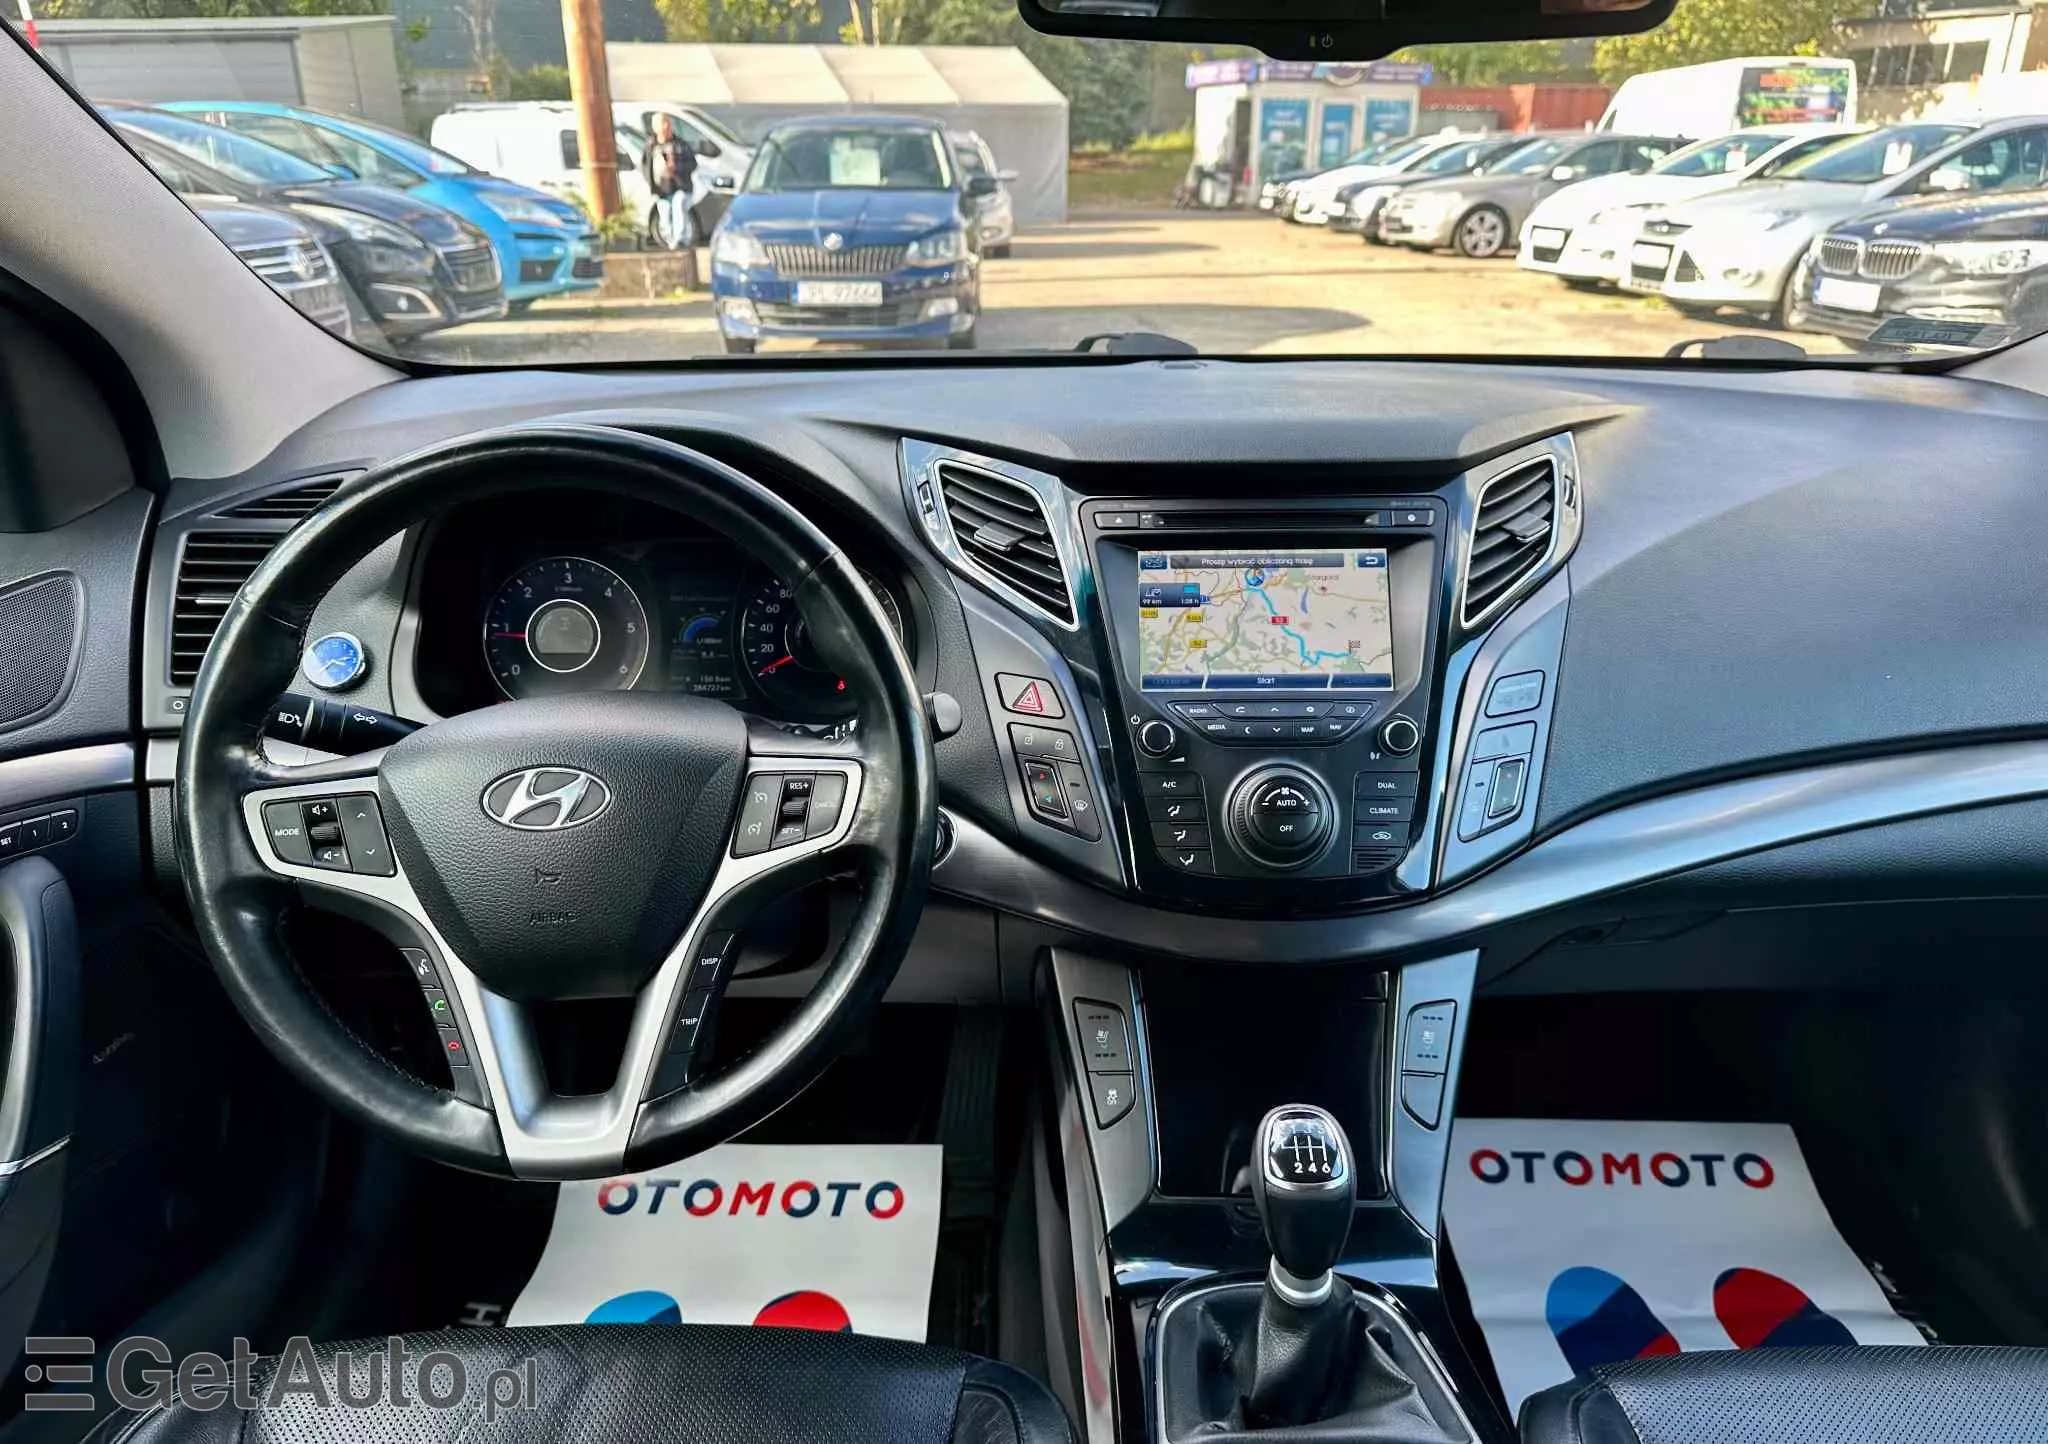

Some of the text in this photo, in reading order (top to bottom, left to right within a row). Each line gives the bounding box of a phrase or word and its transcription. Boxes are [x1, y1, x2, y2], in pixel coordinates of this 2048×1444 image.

[564, 573, 573, 584] 3
[523, 586, 533, 598] 2
[603, 587, 613, 598] 4
[779, 589, 793, 599] 80
[765, 604, 780, 614] 60
[626, 621, 636, 634] 5
[759, 623, 774, 633] 40
[760, 643, 774, 653] 20
[511, 664, 520, 675] 0
[619, 664, 628, 675] 6
[1256, 676, 1275, 685] Start
[1162, 781, 1177, 789] A/C
[1369, 807, 1399, 815] CLIMATE
[274, 827, 300, 837] MODE
[701, 957, 719, 966] DISP
[680, 1017, 699, 1027] TRIP
[1294, 1161, 1331, 1174] 2 4 6
[1469, 1148, 1775, 1189] OTOMOTO
[597, 1178, 905, 1220] OTOMOTO
